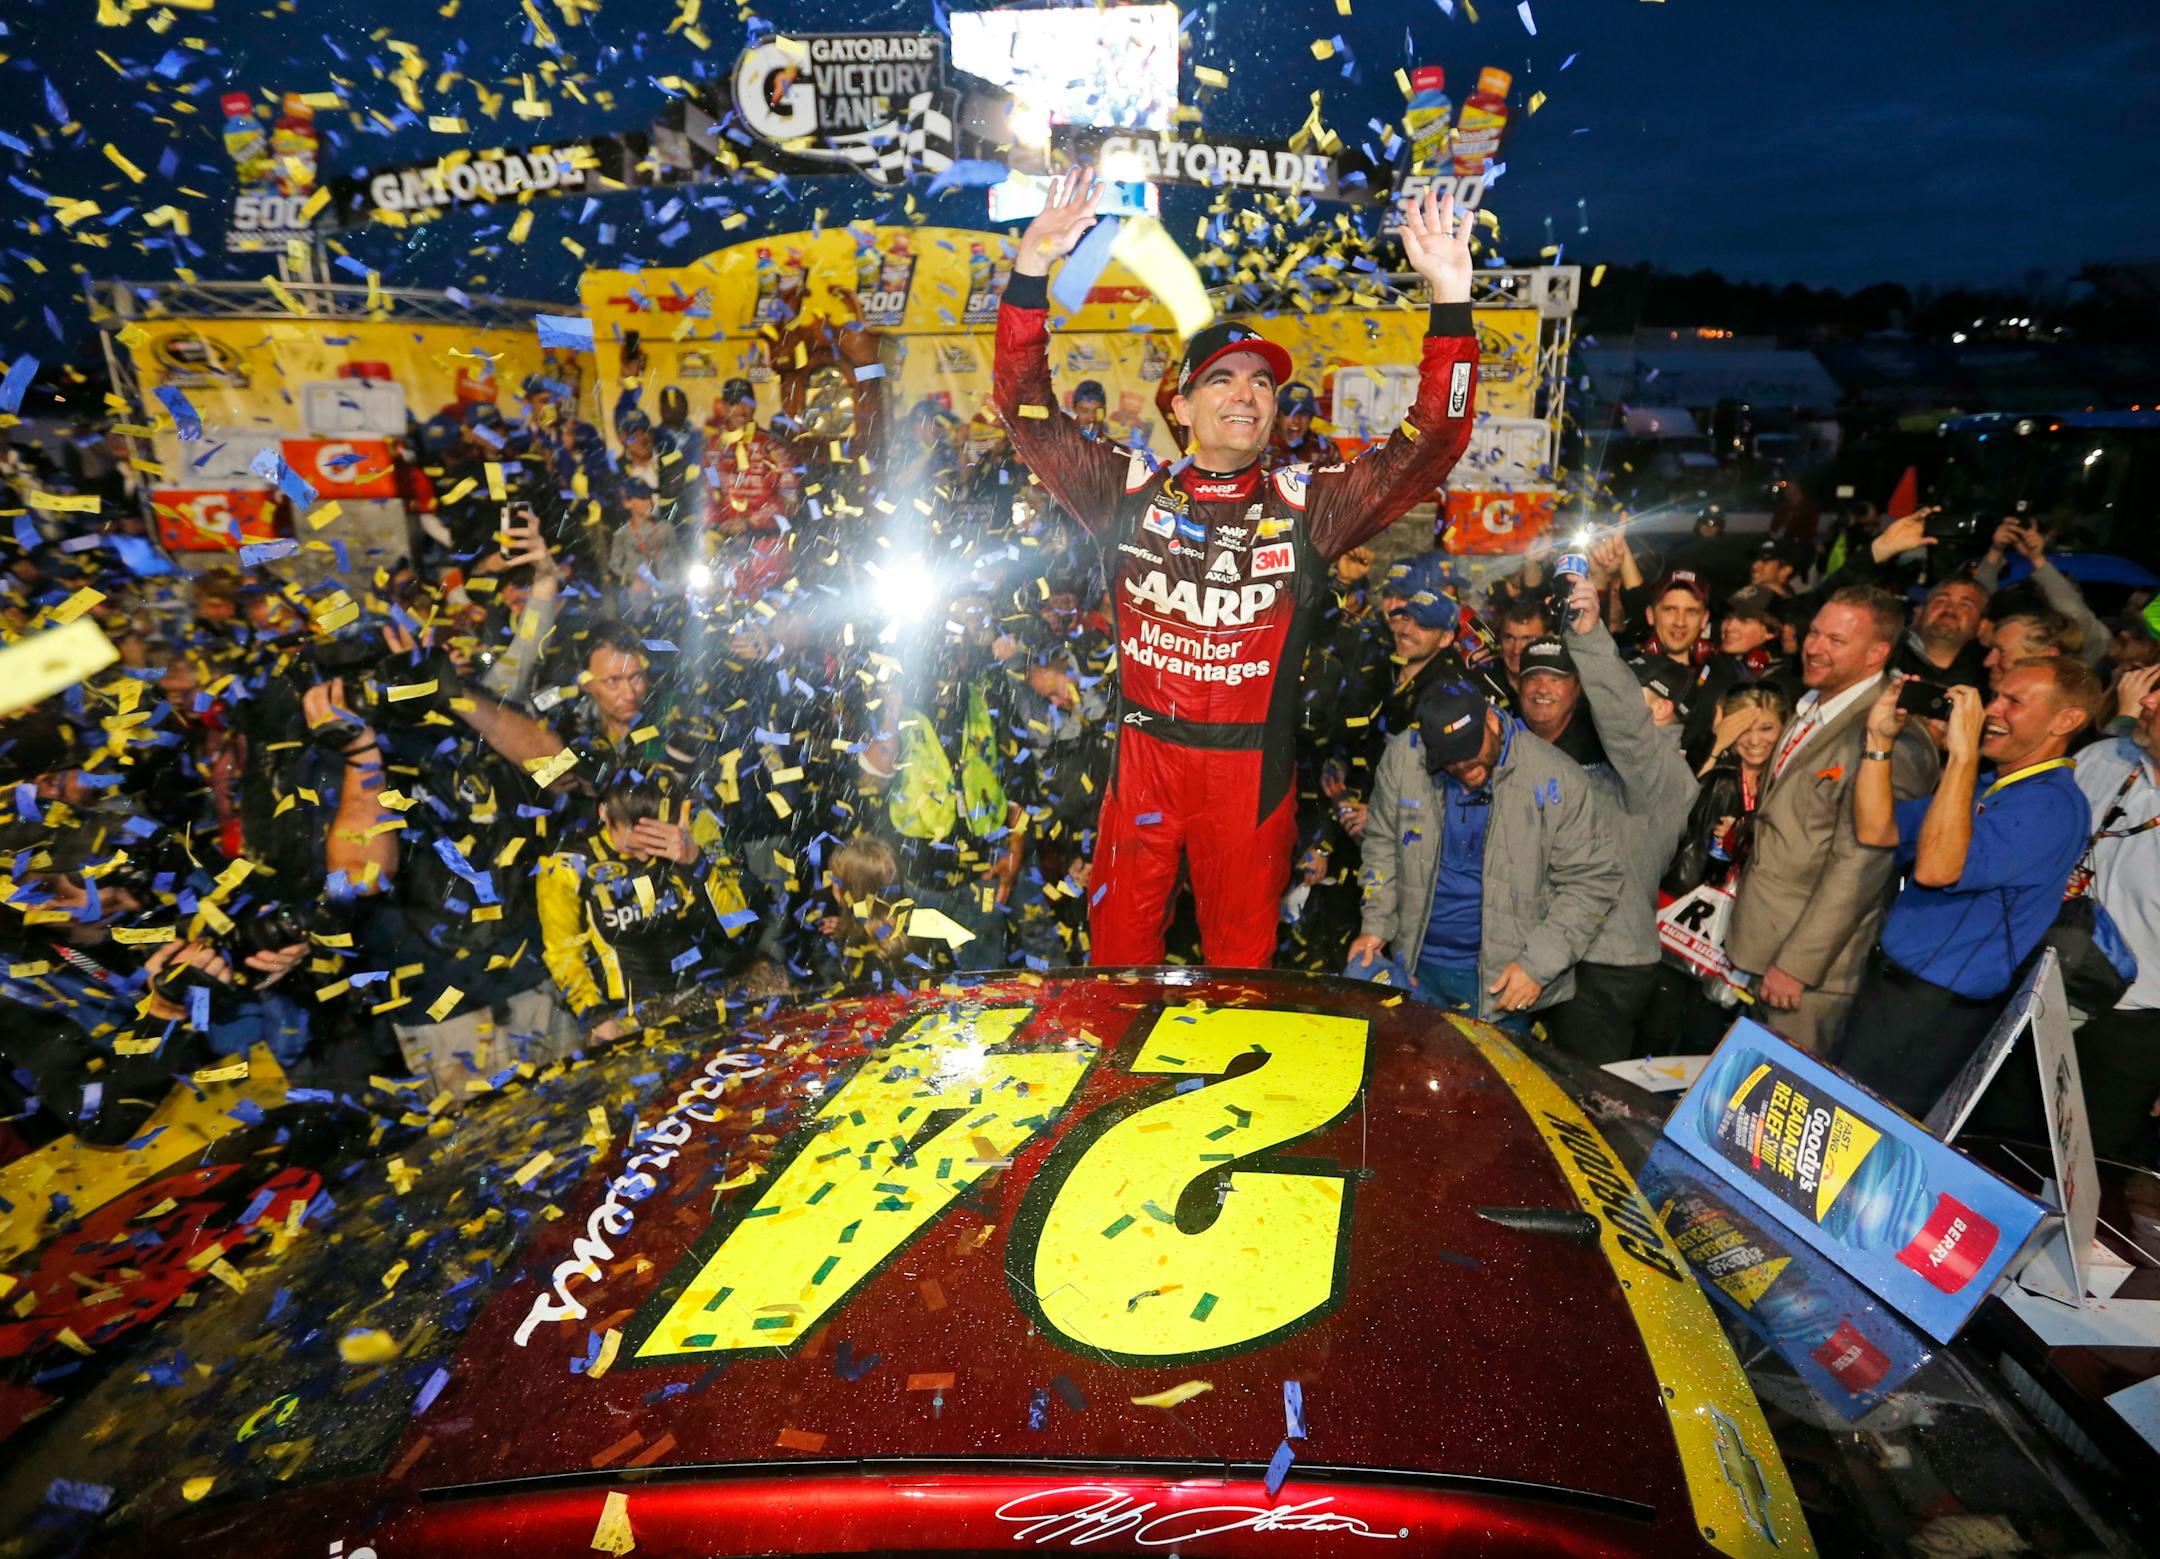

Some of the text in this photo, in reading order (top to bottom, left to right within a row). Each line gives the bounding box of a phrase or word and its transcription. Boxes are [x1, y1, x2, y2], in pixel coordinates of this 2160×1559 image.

[811, 38, 934, 62] GATORADE
[814, 63, 932, 95] VICTORY
[818, 97, 890, 129] LANE
[1256, 549, 1289, 571] 3M
[1140, 620, 1243, 661] Member
[1121, 637, 1270, 686] Advantages
[1765, 1080, 1793, 1141] RELIEF
[1777, 1091, 1810, 1182] HEADACHE
[1797, 1107, 1831, 1194] Goody's
[1829, 1116, 1844, 1154] ACTING
[1841, 1123, 1853, 1152] FAST
[1542, 1111, 1683, 1283] GORDON
[1929, 1216, 1967, 1268] BERRY
